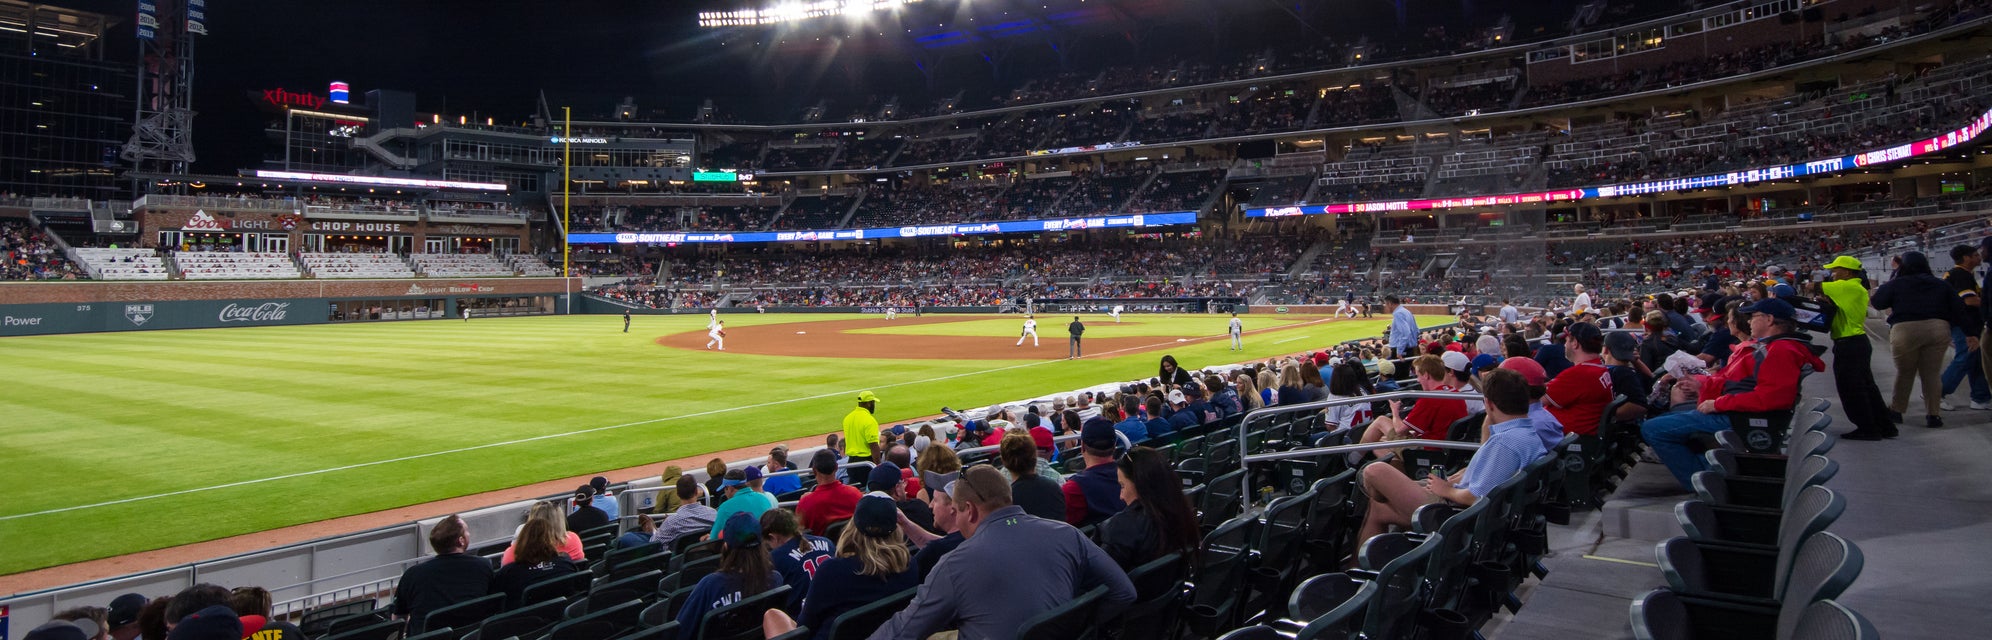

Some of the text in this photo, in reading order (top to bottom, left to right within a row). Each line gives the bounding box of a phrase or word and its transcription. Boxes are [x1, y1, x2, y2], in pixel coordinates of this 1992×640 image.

[140, 16, 154, 25] 2010
[189, 23, 204, 32] 2012
[263, 87, 326, 110] xfinity
[1858, 154, 1867, 166] 19
[1867, 150, 1887, 164] CHRIS
[1886, 144, 1912, 160] STEWART
[1365, 203, 1385, 211] JASON
[1386, 202, 1408, 210] MOTTE
[232, 220, 271, 229] LIGHT
[312, 221, 400, 232] CHOP HOUSE
[1044, 220, 1063, 229] EVERY
[1087, 218, 1105, 227] GAME
[918, 226, 957, 235] SOUTHEAST
[639, 234, 686, 242] SOUTHEAST
[127, 305, 152, 314] MLB
[219, 302, 290, 322] Coca-Cola
[5, 316, 42, 326] Power
[789, 541, 829, 561] MANN
[242, 629, 283, 640] NTE
